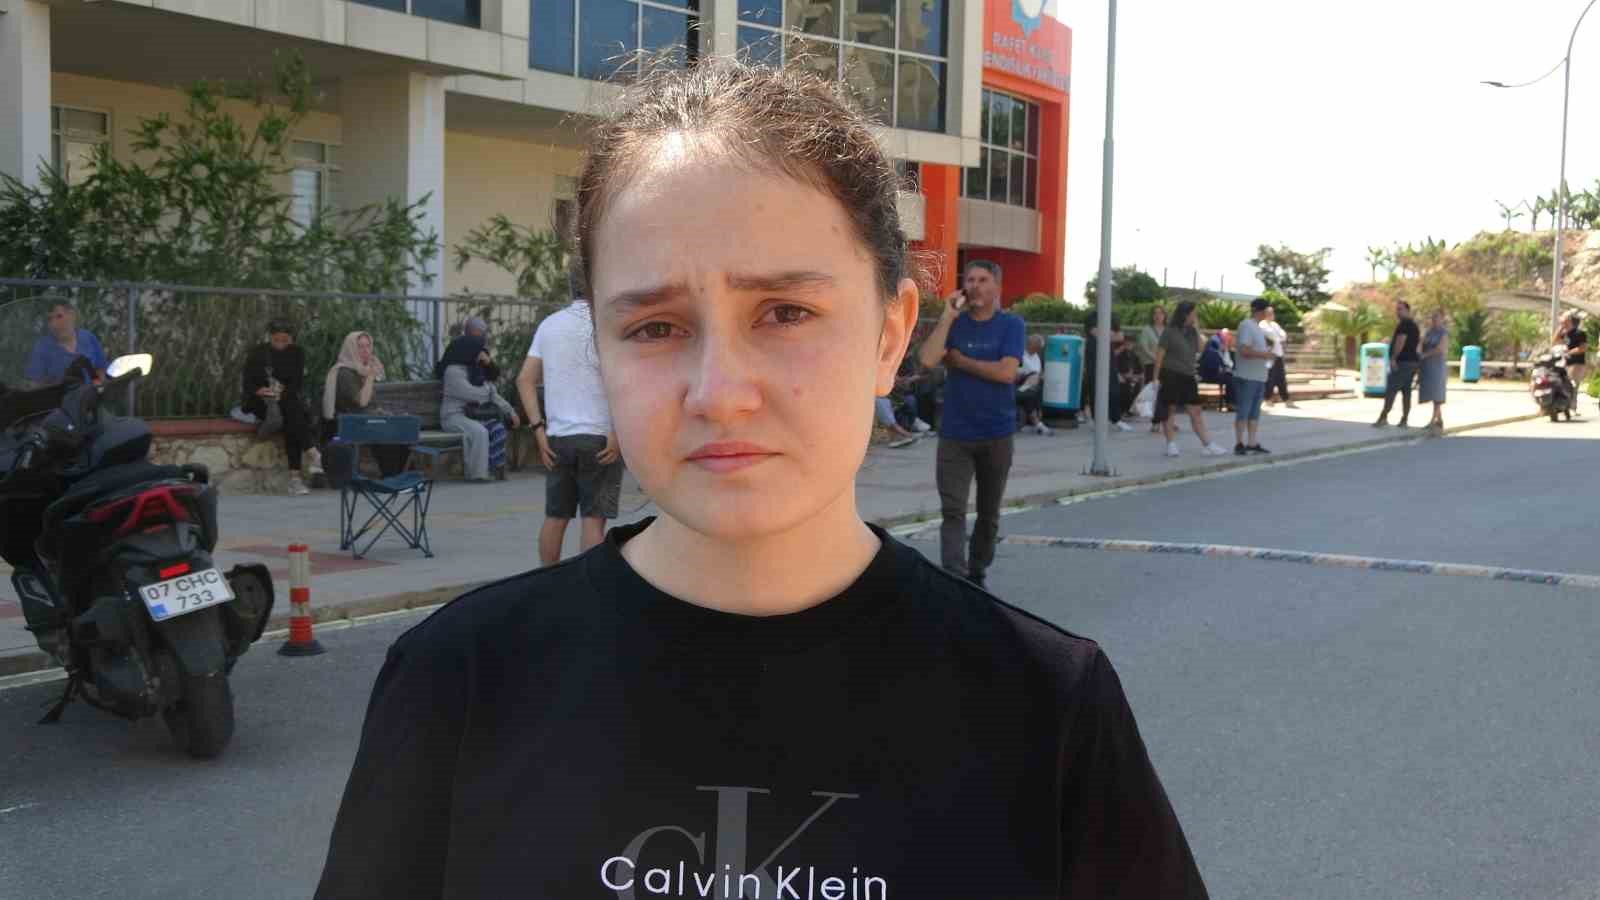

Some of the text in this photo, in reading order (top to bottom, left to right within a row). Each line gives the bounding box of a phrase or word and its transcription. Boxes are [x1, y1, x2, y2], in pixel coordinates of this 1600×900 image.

[147, 571, 218, 600] 07 CHC
[176, 590, 214, 609] 733
[600, 856, 887, 900] Calvin Klein
